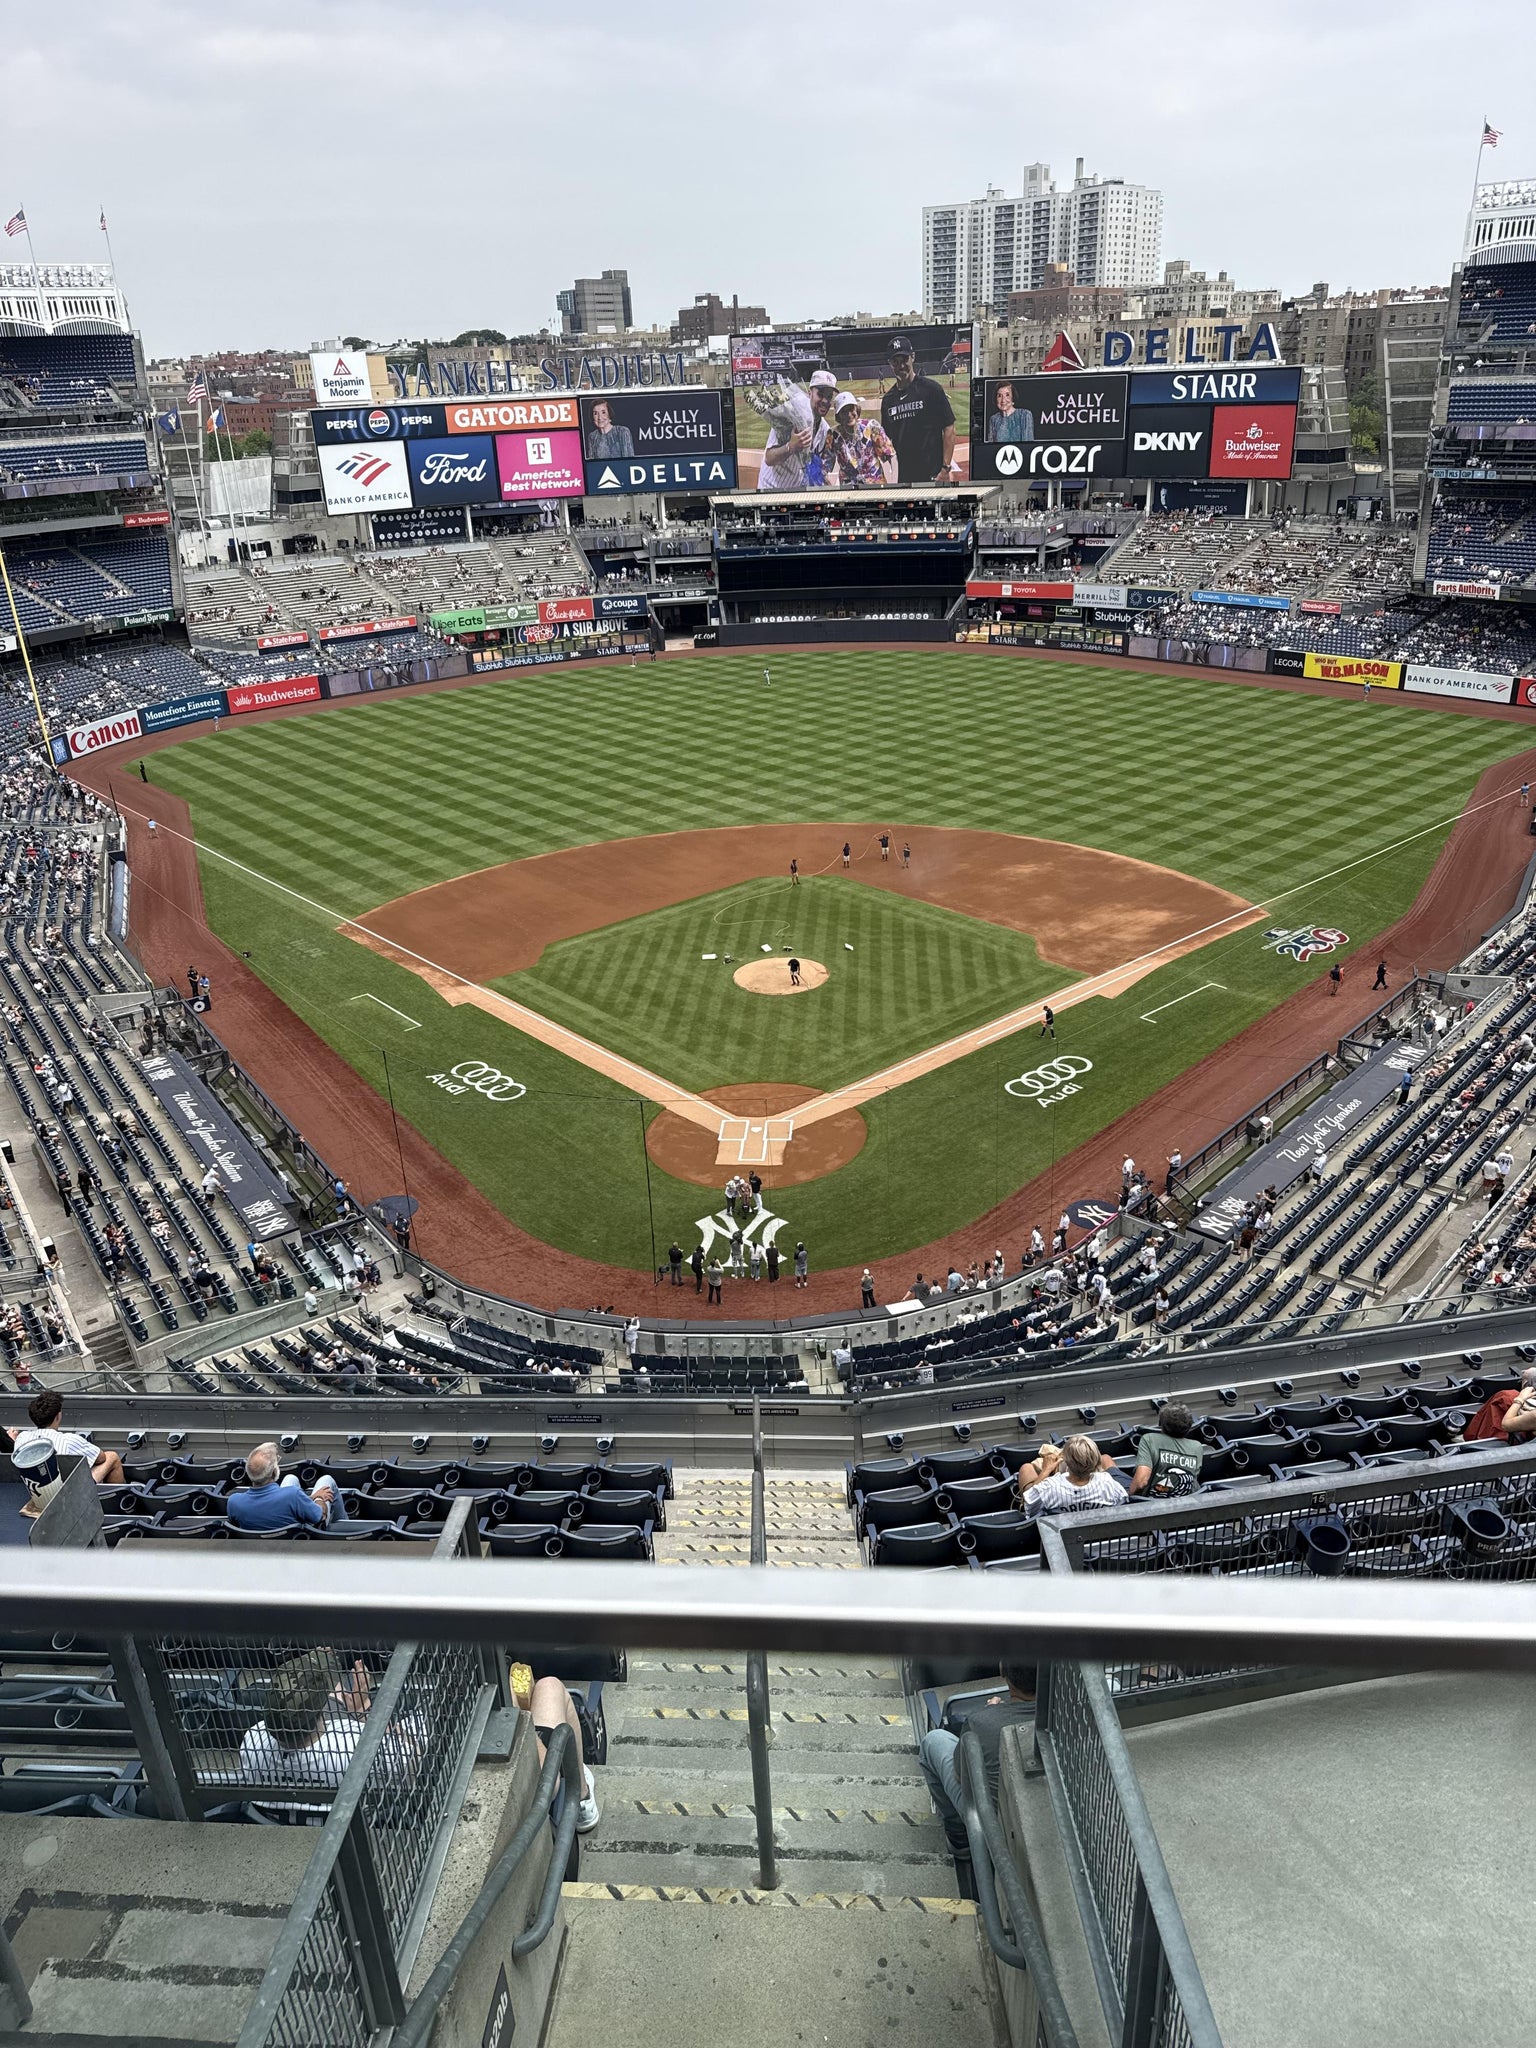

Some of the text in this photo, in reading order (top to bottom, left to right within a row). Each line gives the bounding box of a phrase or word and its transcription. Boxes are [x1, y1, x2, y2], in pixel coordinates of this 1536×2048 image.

[1104, 323, 1281, 366] DELTA
[323, 377, 365, 389] Benjamin
[387, 353, 687, 398] YANKEE STADIUM
[330, 388, 359, 397] Moore
[1171, 373, 1257, 400] STARR
[896, 401, 924, 414] YANKEES
[1056, 393, 1105, 408] SALLY
[370, 418, 389, 426] PEPSI
[401, 415, 432, 425] PEPSI
[454, 402, 572, 428] GATORADE
[653, 410, 699, 425] SALLY
[1040, 409, 1120, 424] MUSCHEL
[326, 419, 357, 430] PEPSI
[639, 424, 717, 440] MUSCHEL
[1133, 431, 1203, 451] DKNY
[1225, 439, 1281, 452] Budweiser
[1029, 445, 1102, 473] razr
[420, 453, 487, 485] Ford
[511, 468, 571, 481] America's
[629, 461, 726, 485] DELTA
[503, 477, 582, 493] Best Network
[328, 491, 409, 506] BANK OF AMERICA
[138, 515, 169, 523] Budweiser
[1074, 593, 1107, 601] MERRILL
[1436, 584, 1457, 593] Parts
[1458, 584, 1496, 596] Authority
[613, 599, 637, 608] coupa
[124, 613, 170, 626] Poland Spring
[458, 616, 483, 627] Eats
[1094, 611, 1131, 623] StubHub
[563, 618, 629, 638] A SUB ABOVE
[994, 636, 1018, 645] STARR
[597, 647, 620, 656] STARR
[476, 653, 564, 672] StubHub StubHub StubHub
[1274, 658, 1303, 668] LEGORA
[1407, 675, 1488, 691] BANK OF AMERICA
[254, 687, 317, 704] Budweiser
[145, 698, 220, 721] Montefiore Einstein
[70, 716, 140, 754] Canon
[425, 1073, 470, 1096] Audi
[1036, 1082, 1084, 1108] Audi
[172, 1091, 199, 1121] Welcome
[186, 1122, 221, 1153] Yankee
[215, 1151, 243, 1183] Stadium
[1276, 1098, 1362, 1163] New York Yankees
[1160, 1452, 1178, 1463] KEEP
